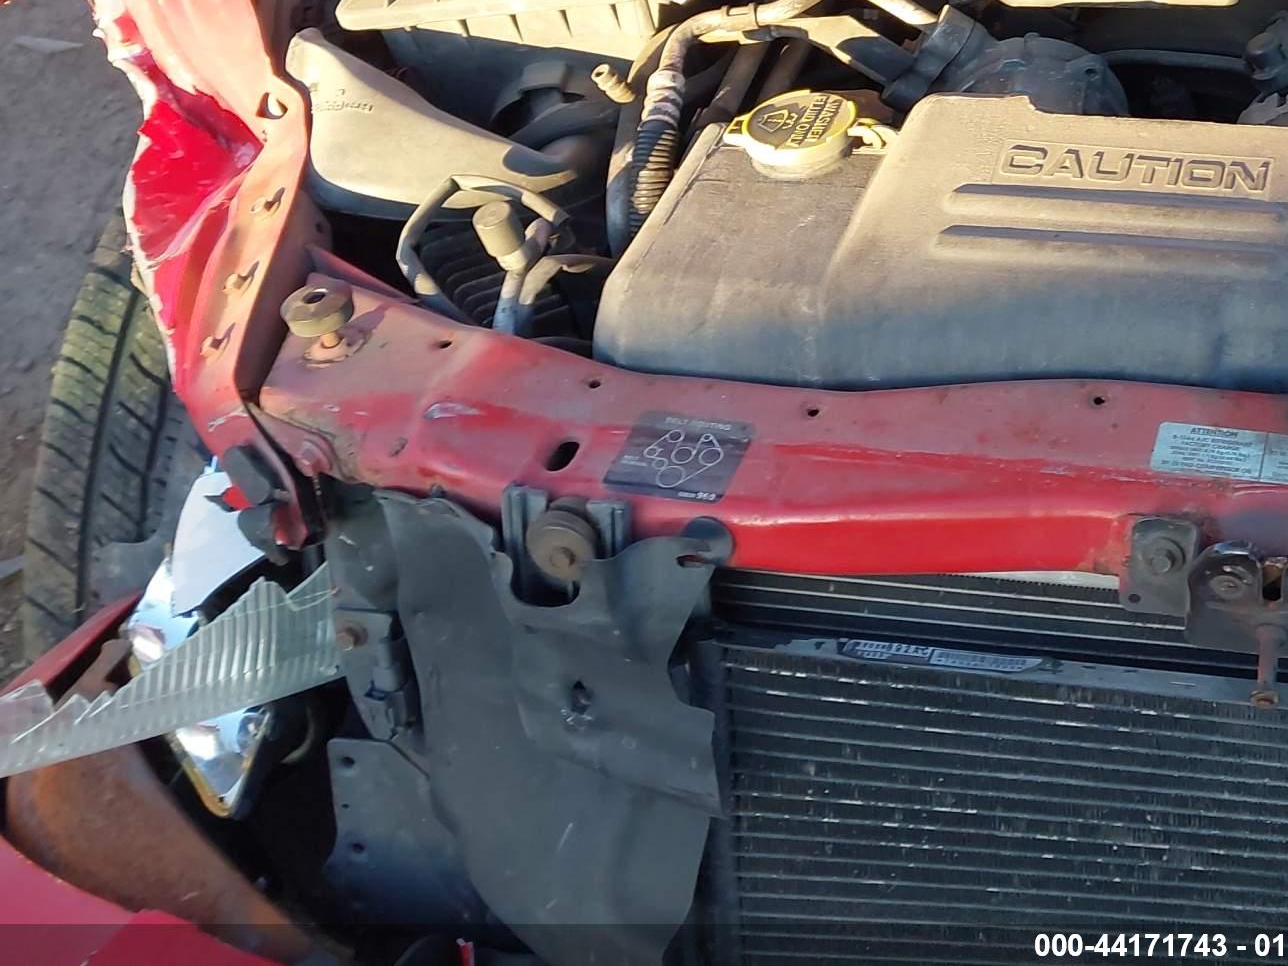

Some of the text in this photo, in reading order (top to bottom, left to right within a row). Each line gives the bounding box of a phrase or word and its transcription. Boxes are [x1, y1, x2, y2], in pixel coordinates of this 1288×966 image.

[784, 94, 828, 147] FLUID ONLY
[803, 97, 843, 143] WASHER
[1000, 144, 1271, 191] CAUTION
